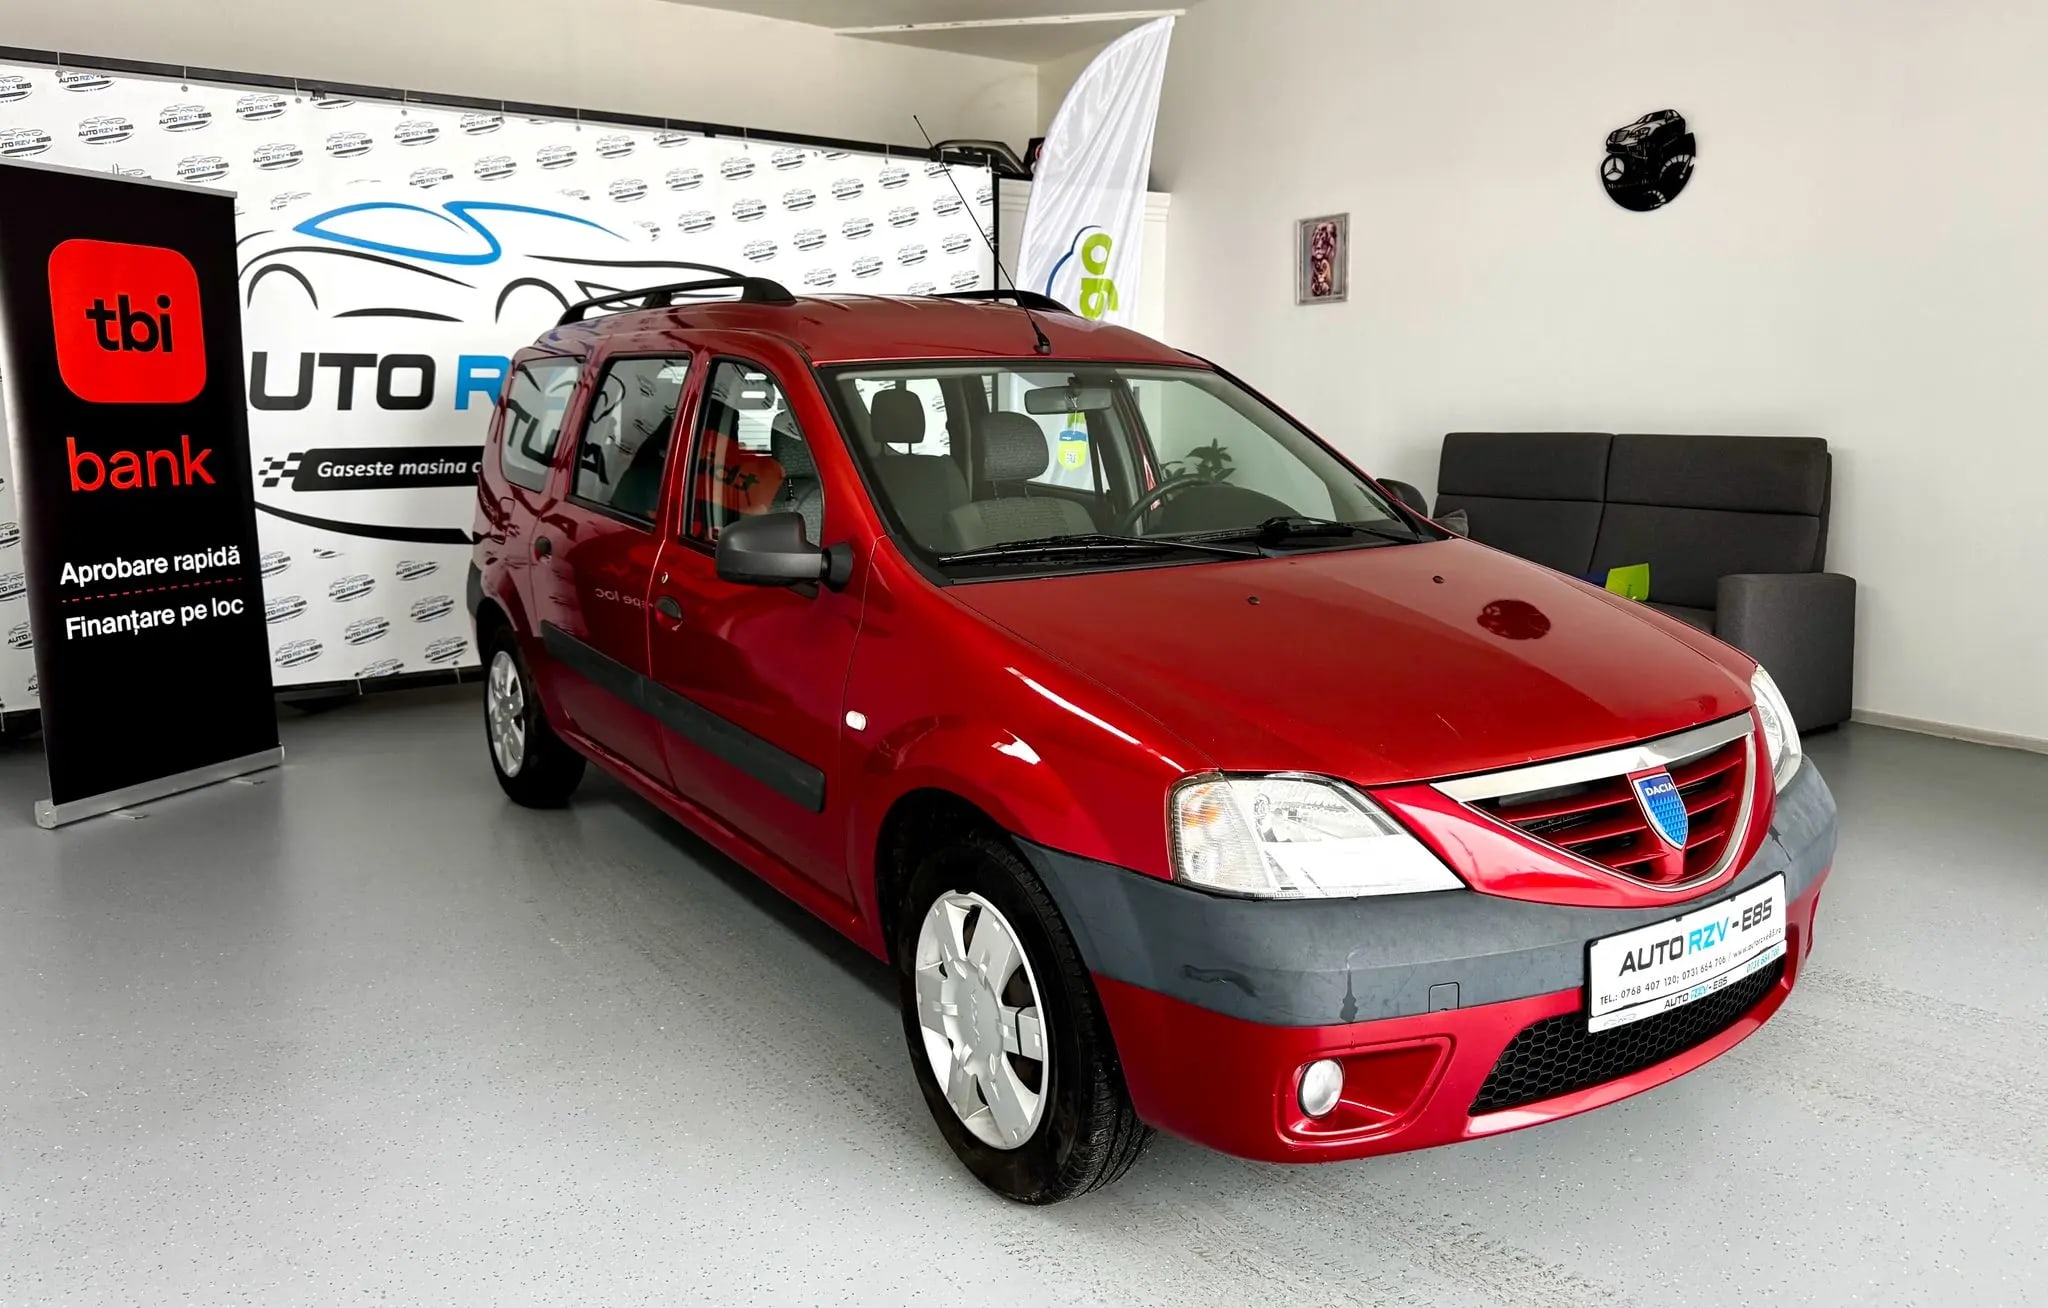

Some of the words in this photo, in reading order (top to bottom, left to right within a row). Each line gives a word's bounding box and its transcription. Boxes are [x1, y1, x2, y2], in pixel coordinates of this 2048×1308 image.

[59, 76, 78, 84] AUTO
[159, 117, 178, 125] AUTO
[78, 129, 98, 137] AUTO
[177, 168, 196, 176] AUTO
[85, 294, 174, 353] tbi
[66, 435, 216, 492] bank
[317, 460, 394, 478] Gaseste
[400, 459, 467, 475] masina
[60, 557, 169, 588] Aprobare
[174, 545, 241, 574] rapidă
[65, 607, 176, 640] Finanțare
[180, 604, 208, 627] pe
[212, 597, 244, 617] loc
[1645, 783, 1675, 797] DACIA
[1619, 935, 1684, 977] AUTO
[1688, 916, 1730, 955] RZV
[1600, 994, 1618, 1005] TEL.:
[1621, 985, 1641, 999] 0768
[1644, 980, 1661, 991] 407
[1682, 967, 1699, 981] 0731
[1664, 992, 1689, 1009] AUTO
